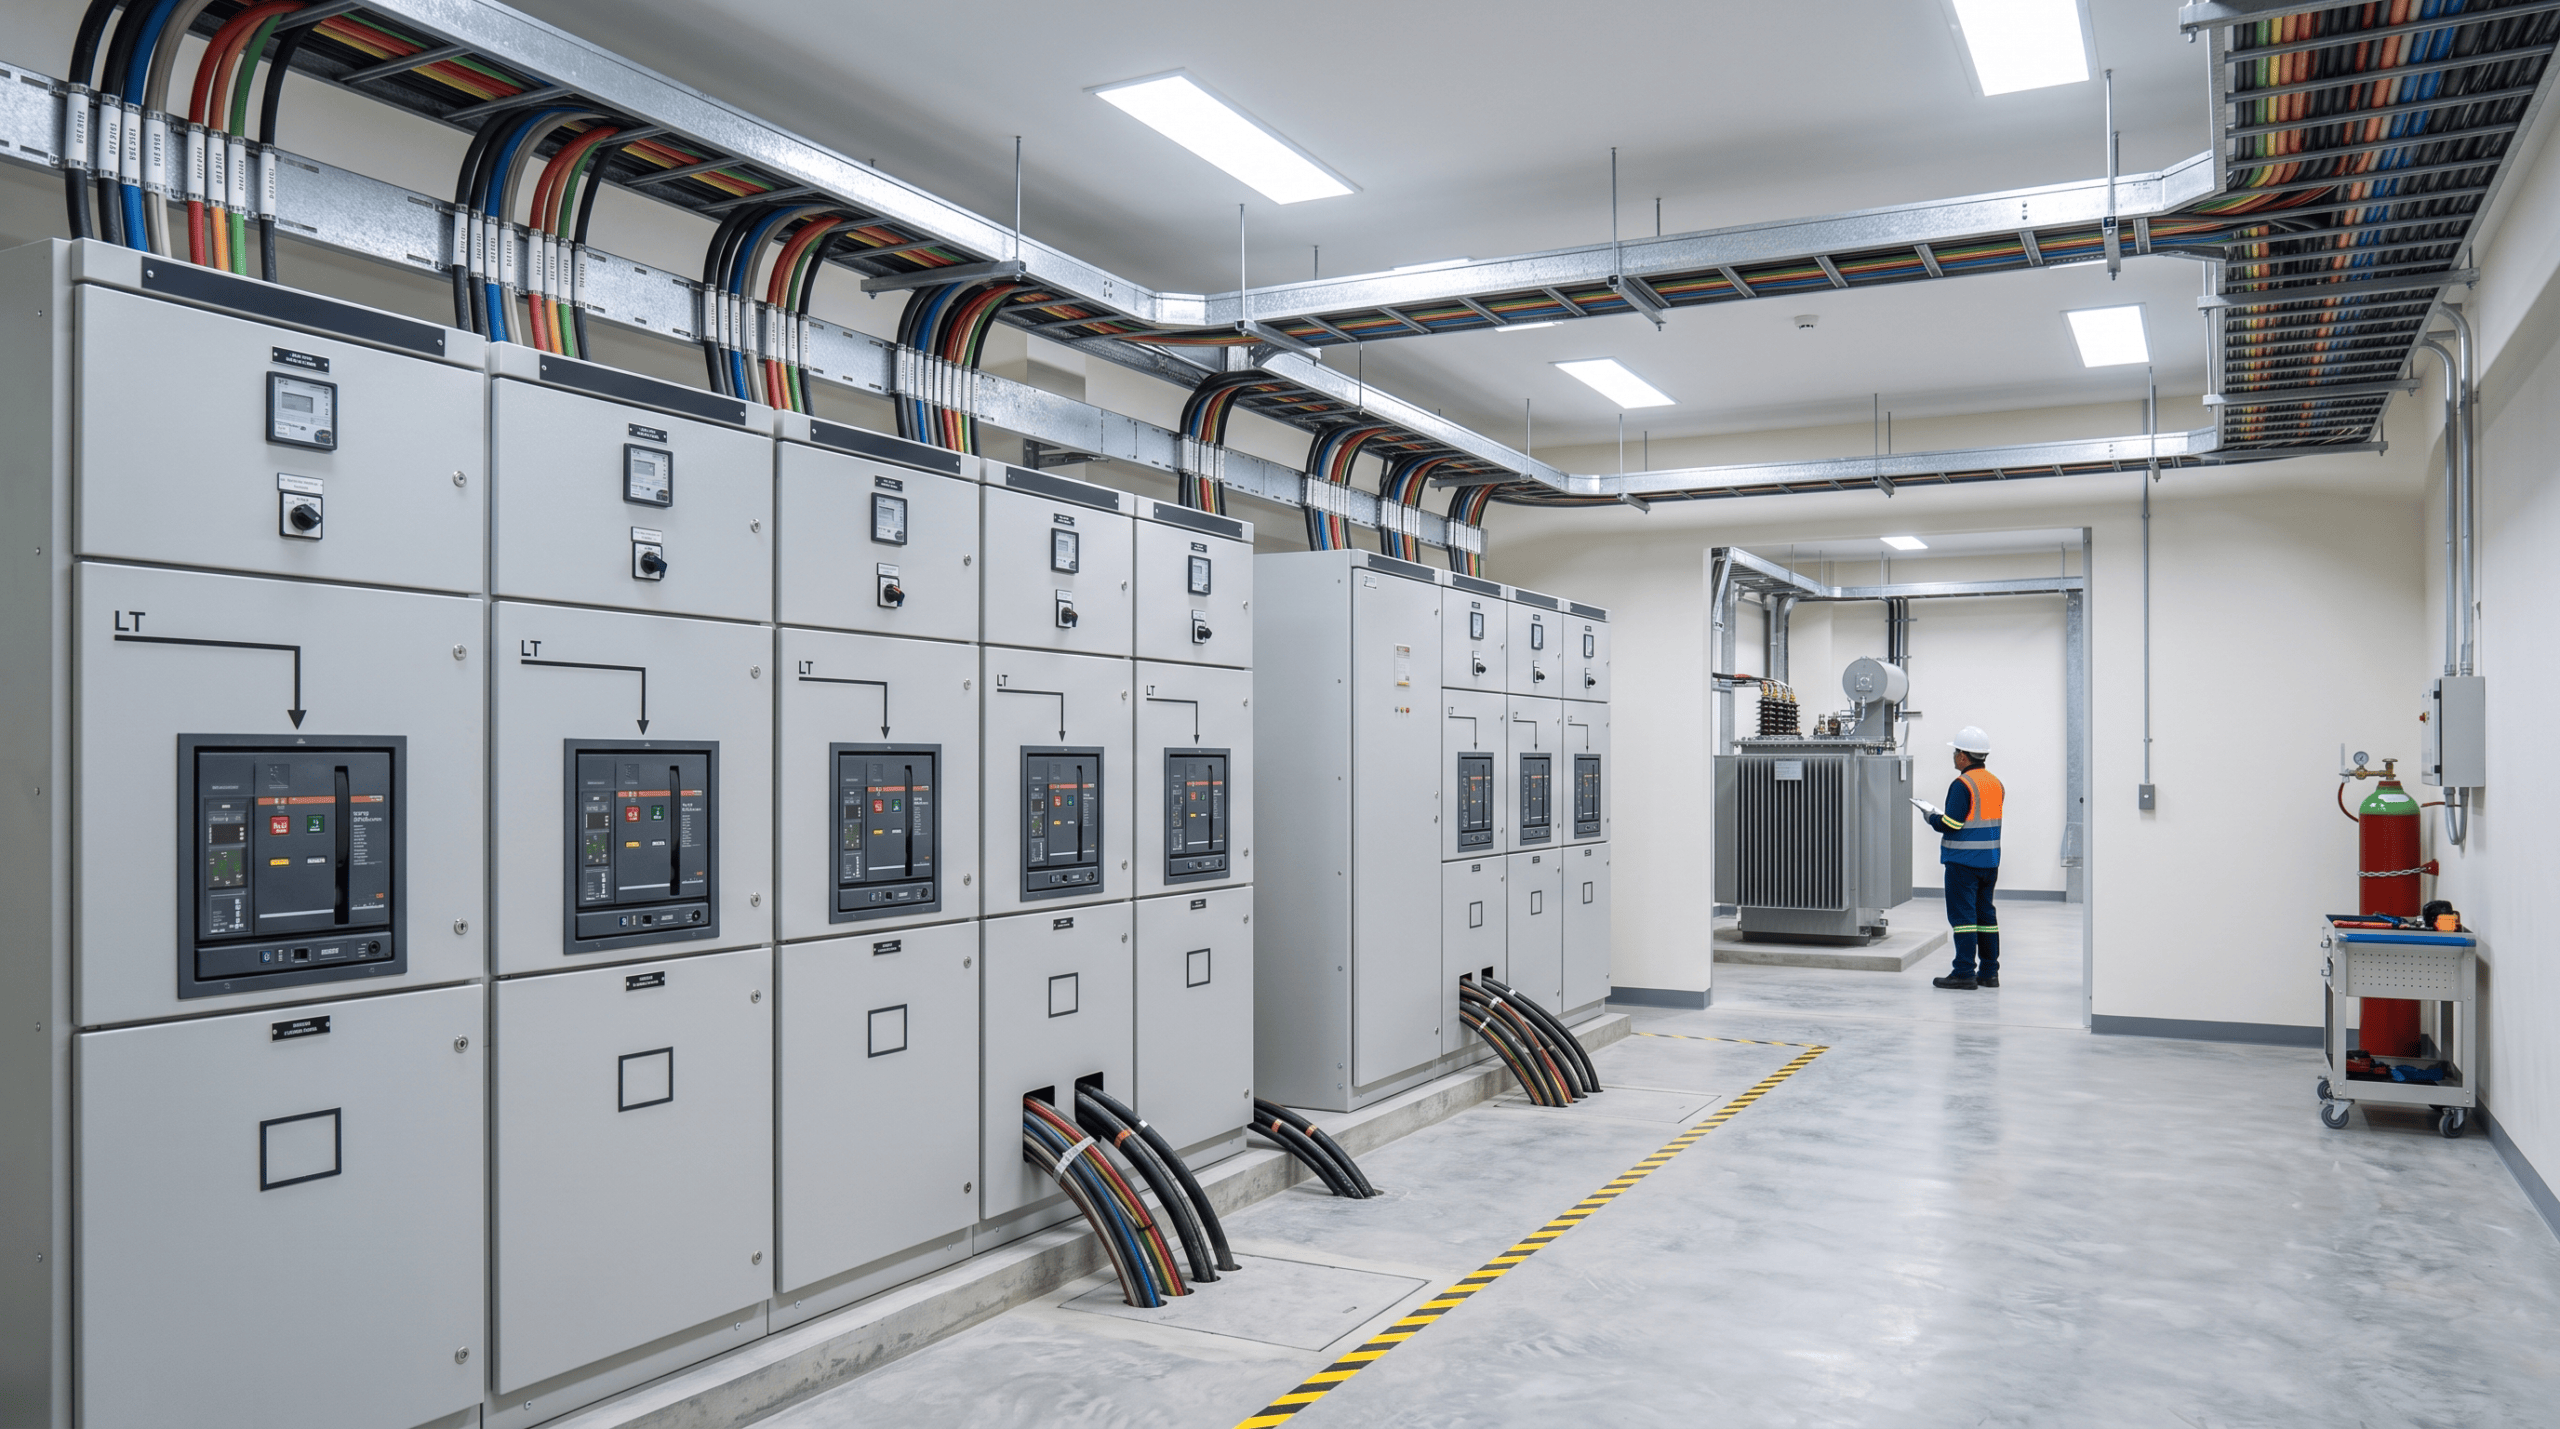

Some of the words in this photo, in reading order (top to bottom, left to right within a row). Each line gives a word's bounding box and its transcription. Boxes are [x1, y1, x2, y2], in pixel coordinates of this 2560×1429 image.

[115, 610, 146, 632] LT
[521, 640, 542, 657] LT
[799, 661, 814, 675] LT
[997, 674, 1008, 687] LT
[1146, 685, 1155, 696] LT
